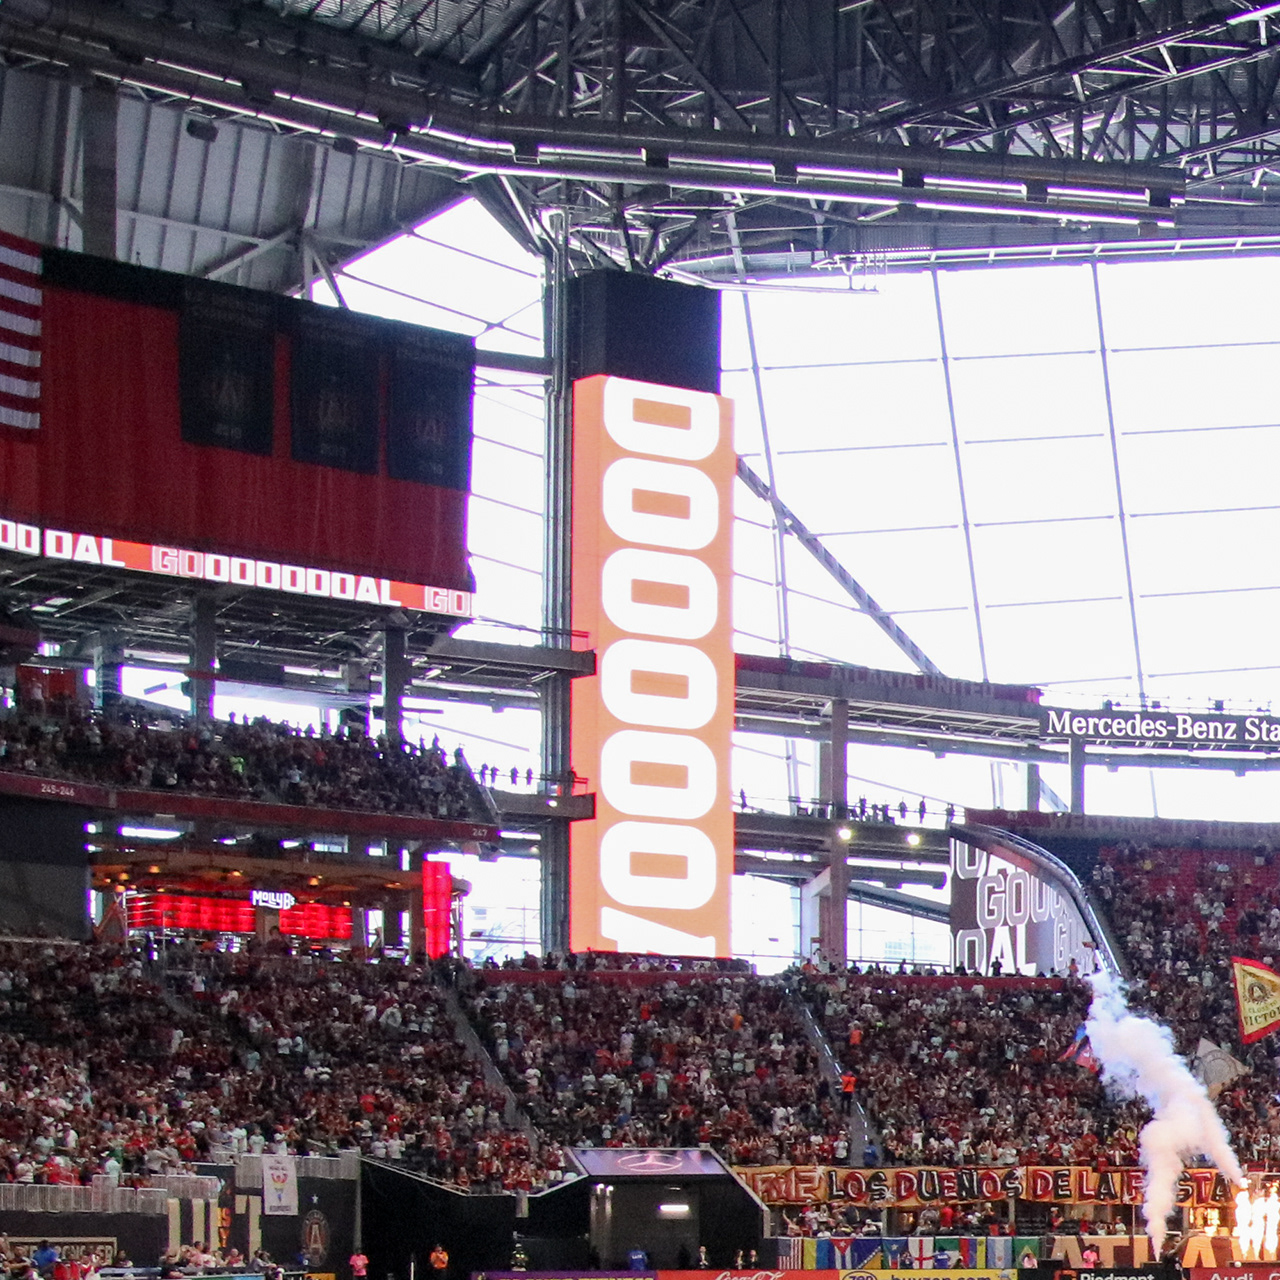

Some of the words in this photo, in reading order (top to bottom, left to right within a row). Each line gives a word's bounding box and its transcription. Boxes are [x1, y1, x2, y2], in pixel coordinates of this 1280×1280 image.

[1047, 710, 1237, 741] Mercedes-Benz
[829, 1170, 889, 1200] LOS
[1033, 1169, 1071, 1198] DE
[1077, 1169, 1118, 1201] LA
[1123, 1169, 1232, 1202] FSTA
